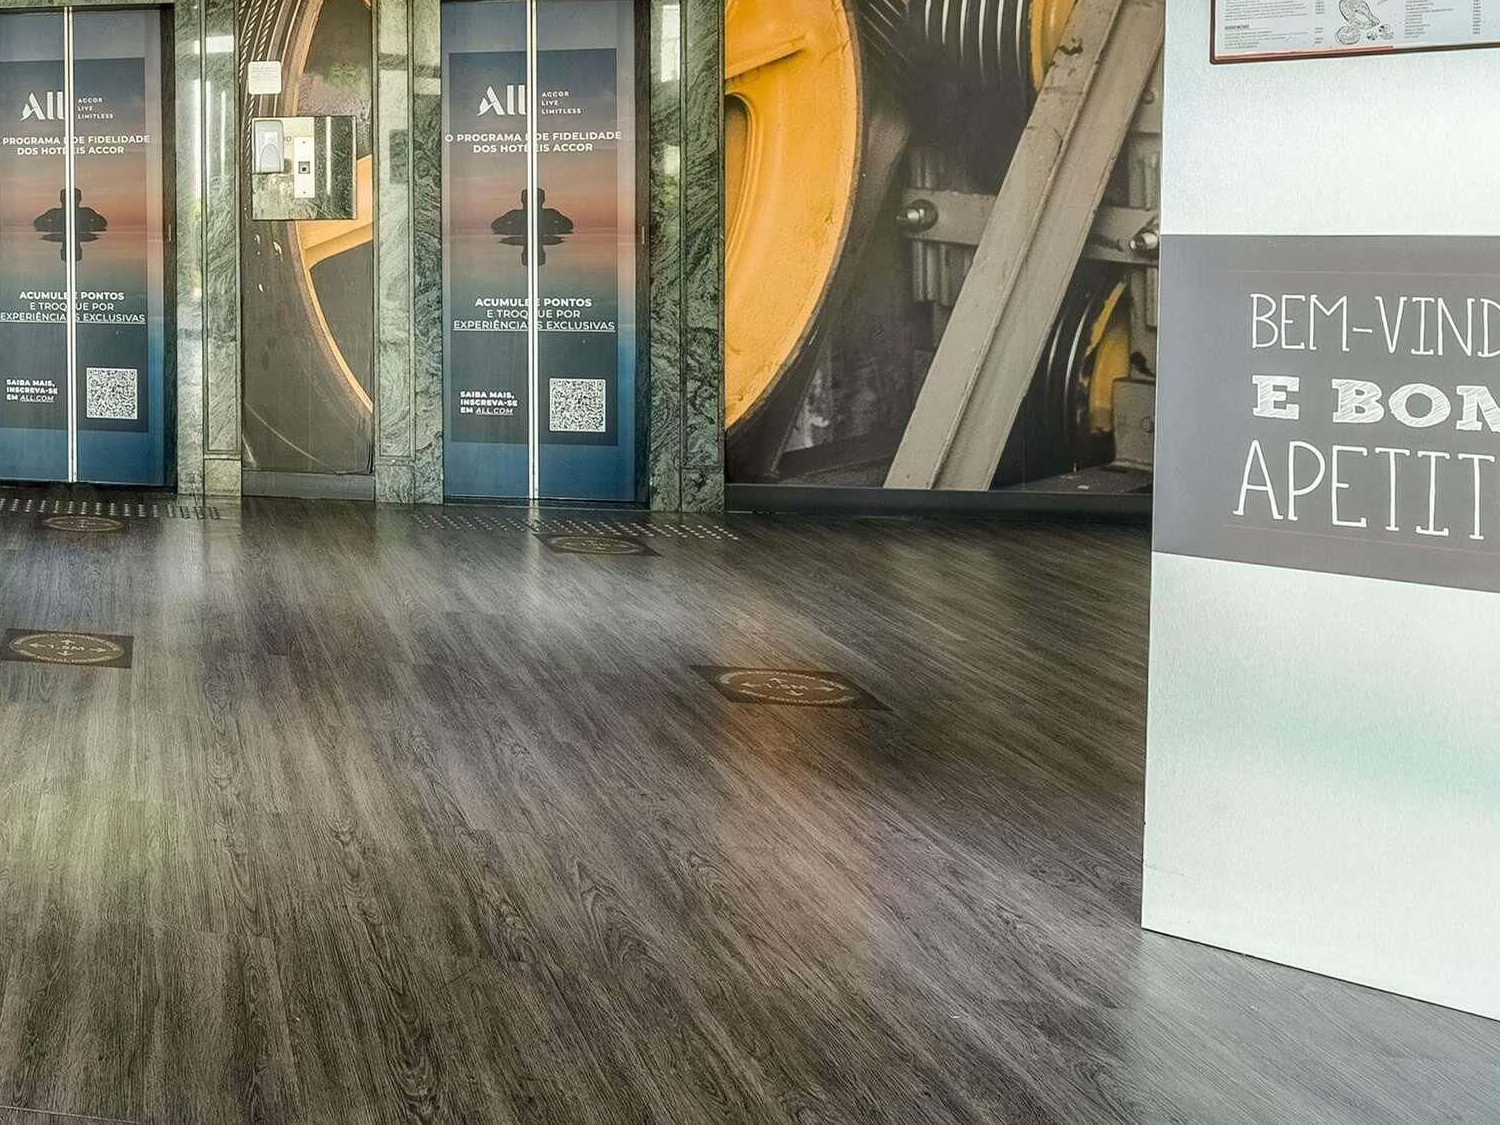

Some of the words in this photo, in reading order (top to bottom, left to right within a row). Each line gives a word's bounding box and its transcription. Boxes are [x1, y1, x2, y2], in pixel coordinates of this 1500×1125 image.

[541, 90, 570, 98] ACCOR
[541, 107, 582, 115] LIMITLESS
[2, 136, 61, 146] PROGRAMA
[88, 134, 151, 144] FIDELIDADE
[444, 133, 454, 143] O
[457, 132, 522, 142] PROGRAMA
[552, 131, 622, 141] FIDELIDADE
[17, 146, 39, 156] DOS
[88, 146, 125, 155] ACCOR
[473, 144, 498, 154] DOS
[552, 143, 594, 152] ACCOR
[80, 291, 125, 301] PONTOS
[30, 302, 36, 311] E
[38, 302, 90, 312] TROQUE
[92, 302, 115, 311] POR
[543, 298, 593, 307] PONTOS
[0, 311, 81, 322] EXPERIÊNCIAS
[83, 313, 146, 323] EXCLUSIVAS
[486, 309, 494, 318] E
[497, 309, 554, 319] TROQUE
[556, 310, 581, 319] POR
[453, 320, 543, 331] EXPERIÊNCIAS
[546, 321, 616, 331] EXCLUSIVAS
[6, 379, 32, 387] SAIBA
[6, 387, 59, 395] INSCREVA-SE
[460, 391, 488, 399] SAIBA
[1252, 375, 1300, 420] E
[460, 399, 518, 407] INSCREVA-SE
[460, 406, 474, 414] EM
